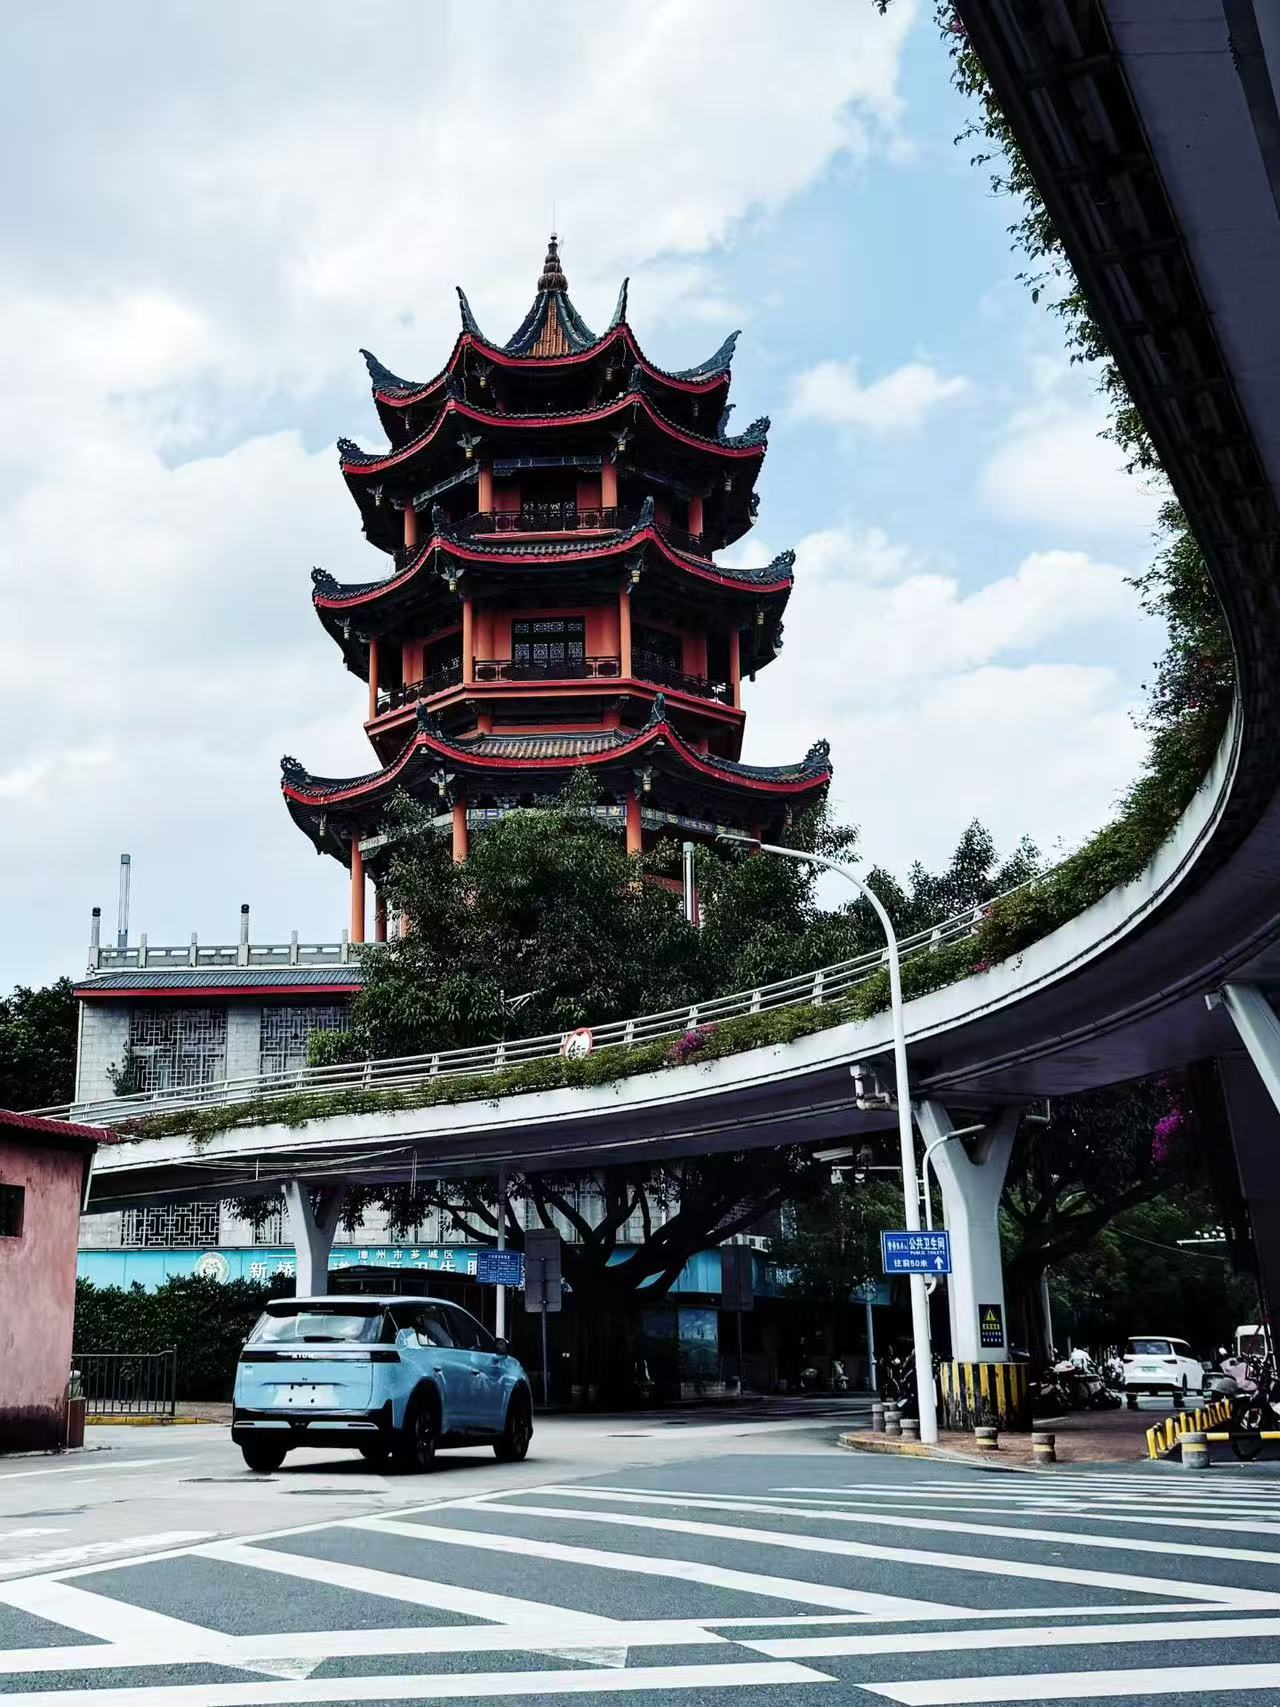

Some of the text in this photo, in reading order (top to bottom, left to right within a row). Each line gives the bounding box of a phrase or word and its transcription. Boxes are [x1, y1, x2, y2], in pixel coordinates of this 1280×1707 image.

[909, 1236, 945, 1250] 公共卫生间
[357, 1249, 454, 1260] 漳州市芗城区
[894, 1259, 928, 1268] 往前50米
